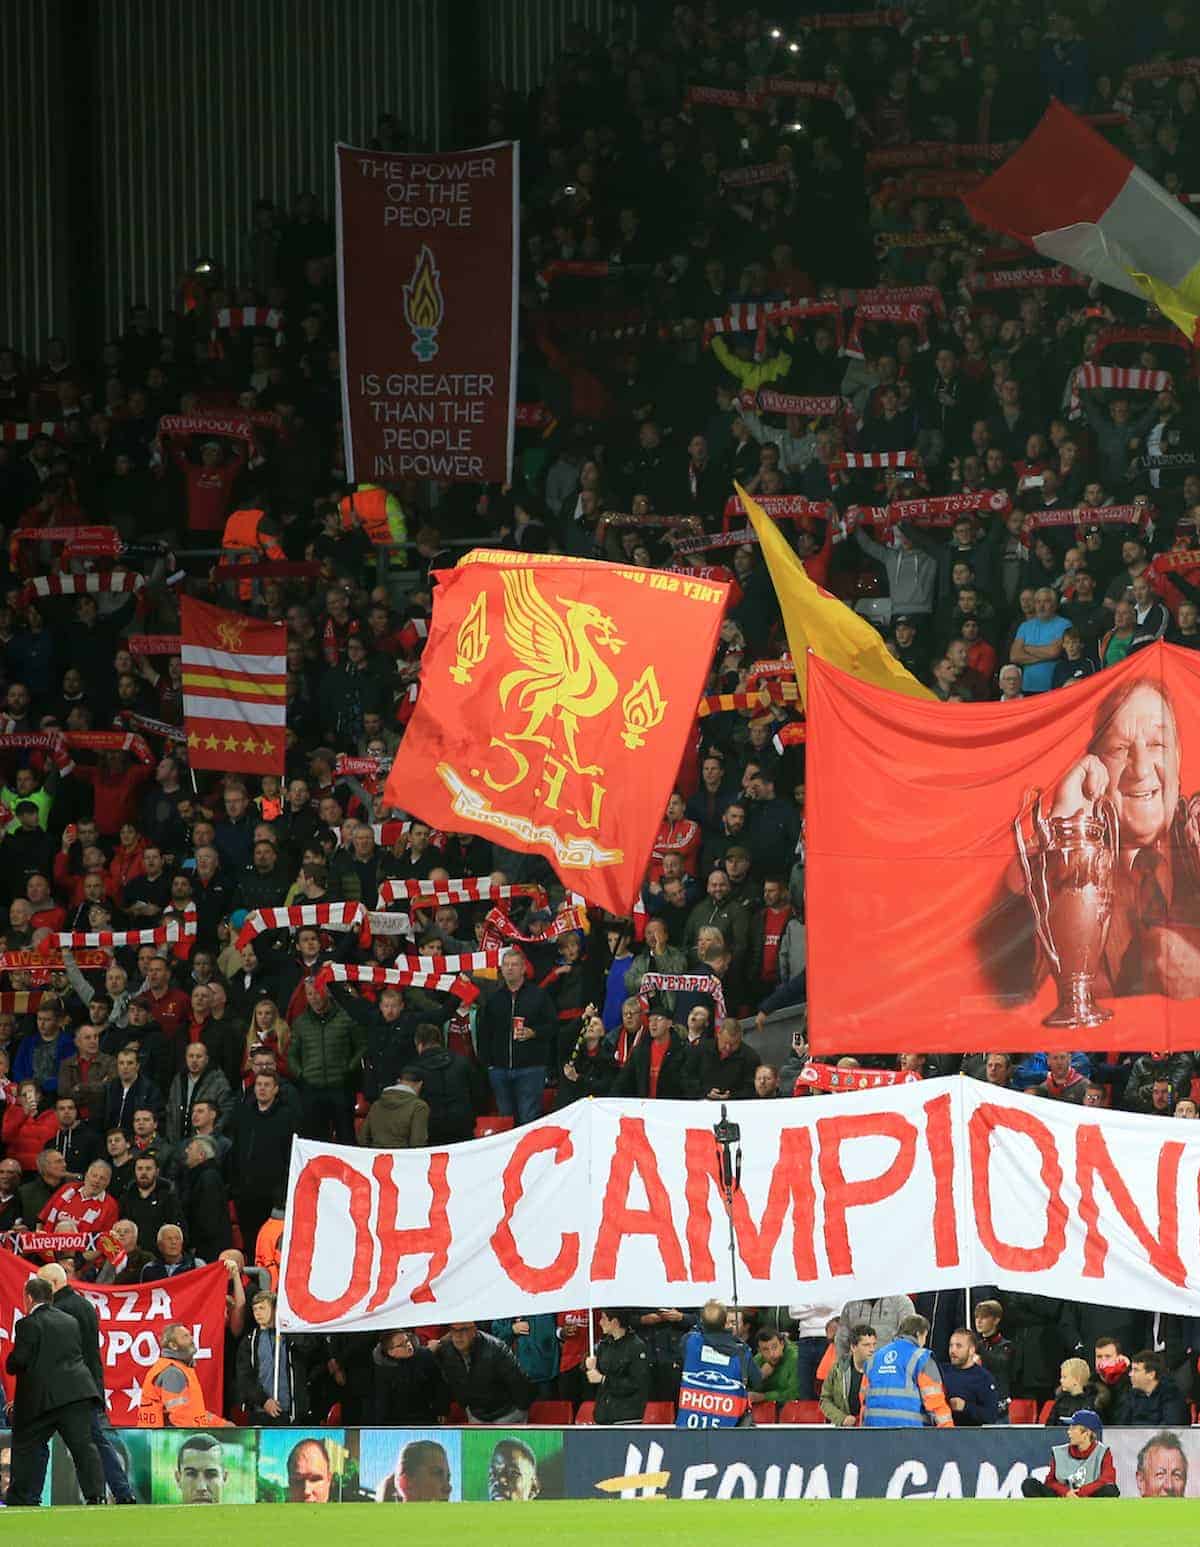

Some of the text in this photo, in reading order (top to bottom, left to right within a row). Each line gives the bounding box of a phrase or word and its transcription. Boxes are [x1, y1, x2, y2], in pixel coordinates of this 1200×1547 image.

[359, 158, 497, 182] THE POWER
[386, 183, 471, 203] OF THE
[383, 207, 473, 227] PEOPLE
[359, 373, 495, 396] IS GREATER
[369, 401, 485, 424] THAN THE
[383, 429, 473, 451] PEOPLE
[374, 455, 484, 476] IN POWER
[21, 1231, 88, 1252] Liverpool
[284, 1153, 452, 1324] OH
[680, 1391, 733, 1413] PHOTO
